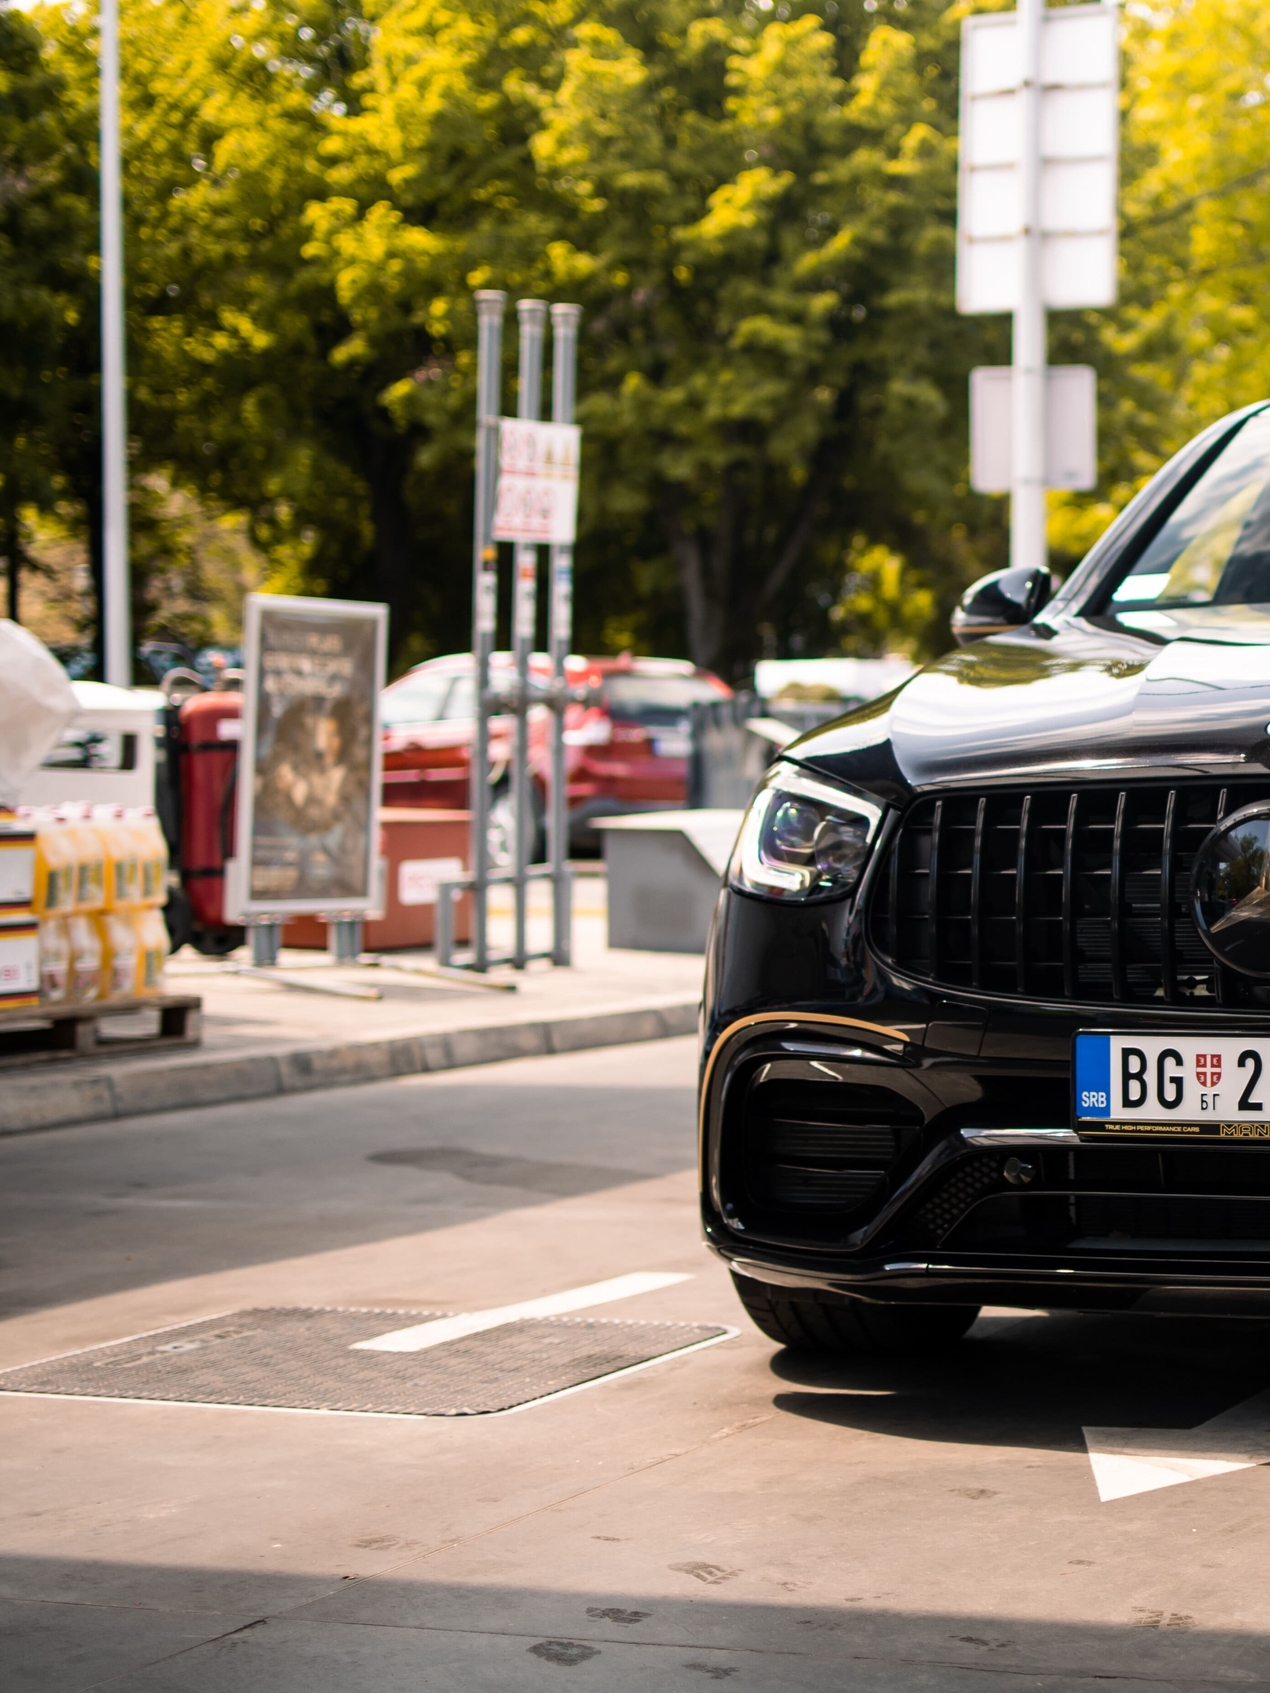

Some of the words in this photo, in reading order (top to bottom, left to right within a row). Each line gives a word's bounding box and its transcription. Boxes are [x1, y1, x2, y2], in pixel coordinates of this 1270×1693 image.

[1120, 1047, 1184, 1110] BG
[1081, 1091, 1107, 1108] SRB
[1200, 1093, 1220, 1111] БГ
